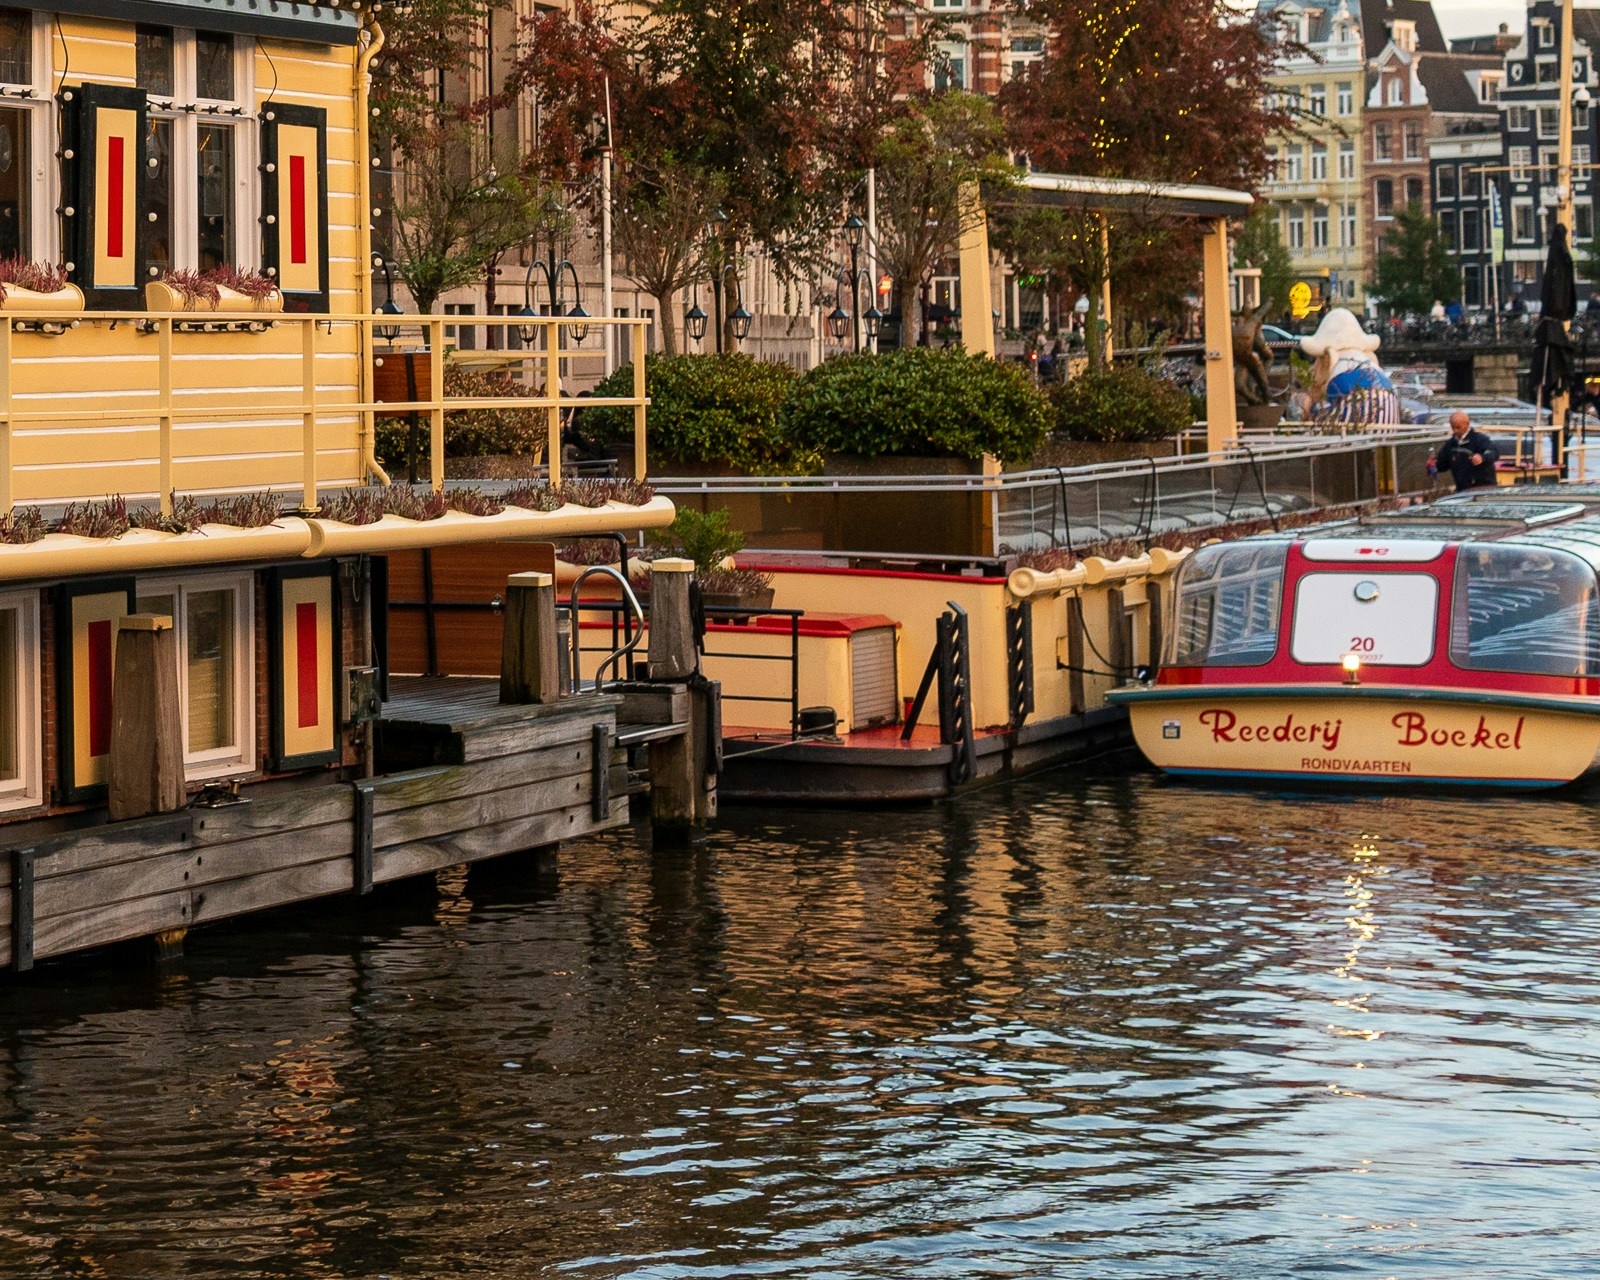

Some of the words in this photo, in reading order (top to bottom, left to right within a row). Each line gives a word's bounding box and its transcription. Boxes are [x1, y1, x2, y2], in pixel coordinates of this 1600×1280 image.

[1350, 636, 1375, 652] 20
[1391, 711, 1525, 750] Boekel
[1301, 757, 1412, 773] RONDVAARTEN
